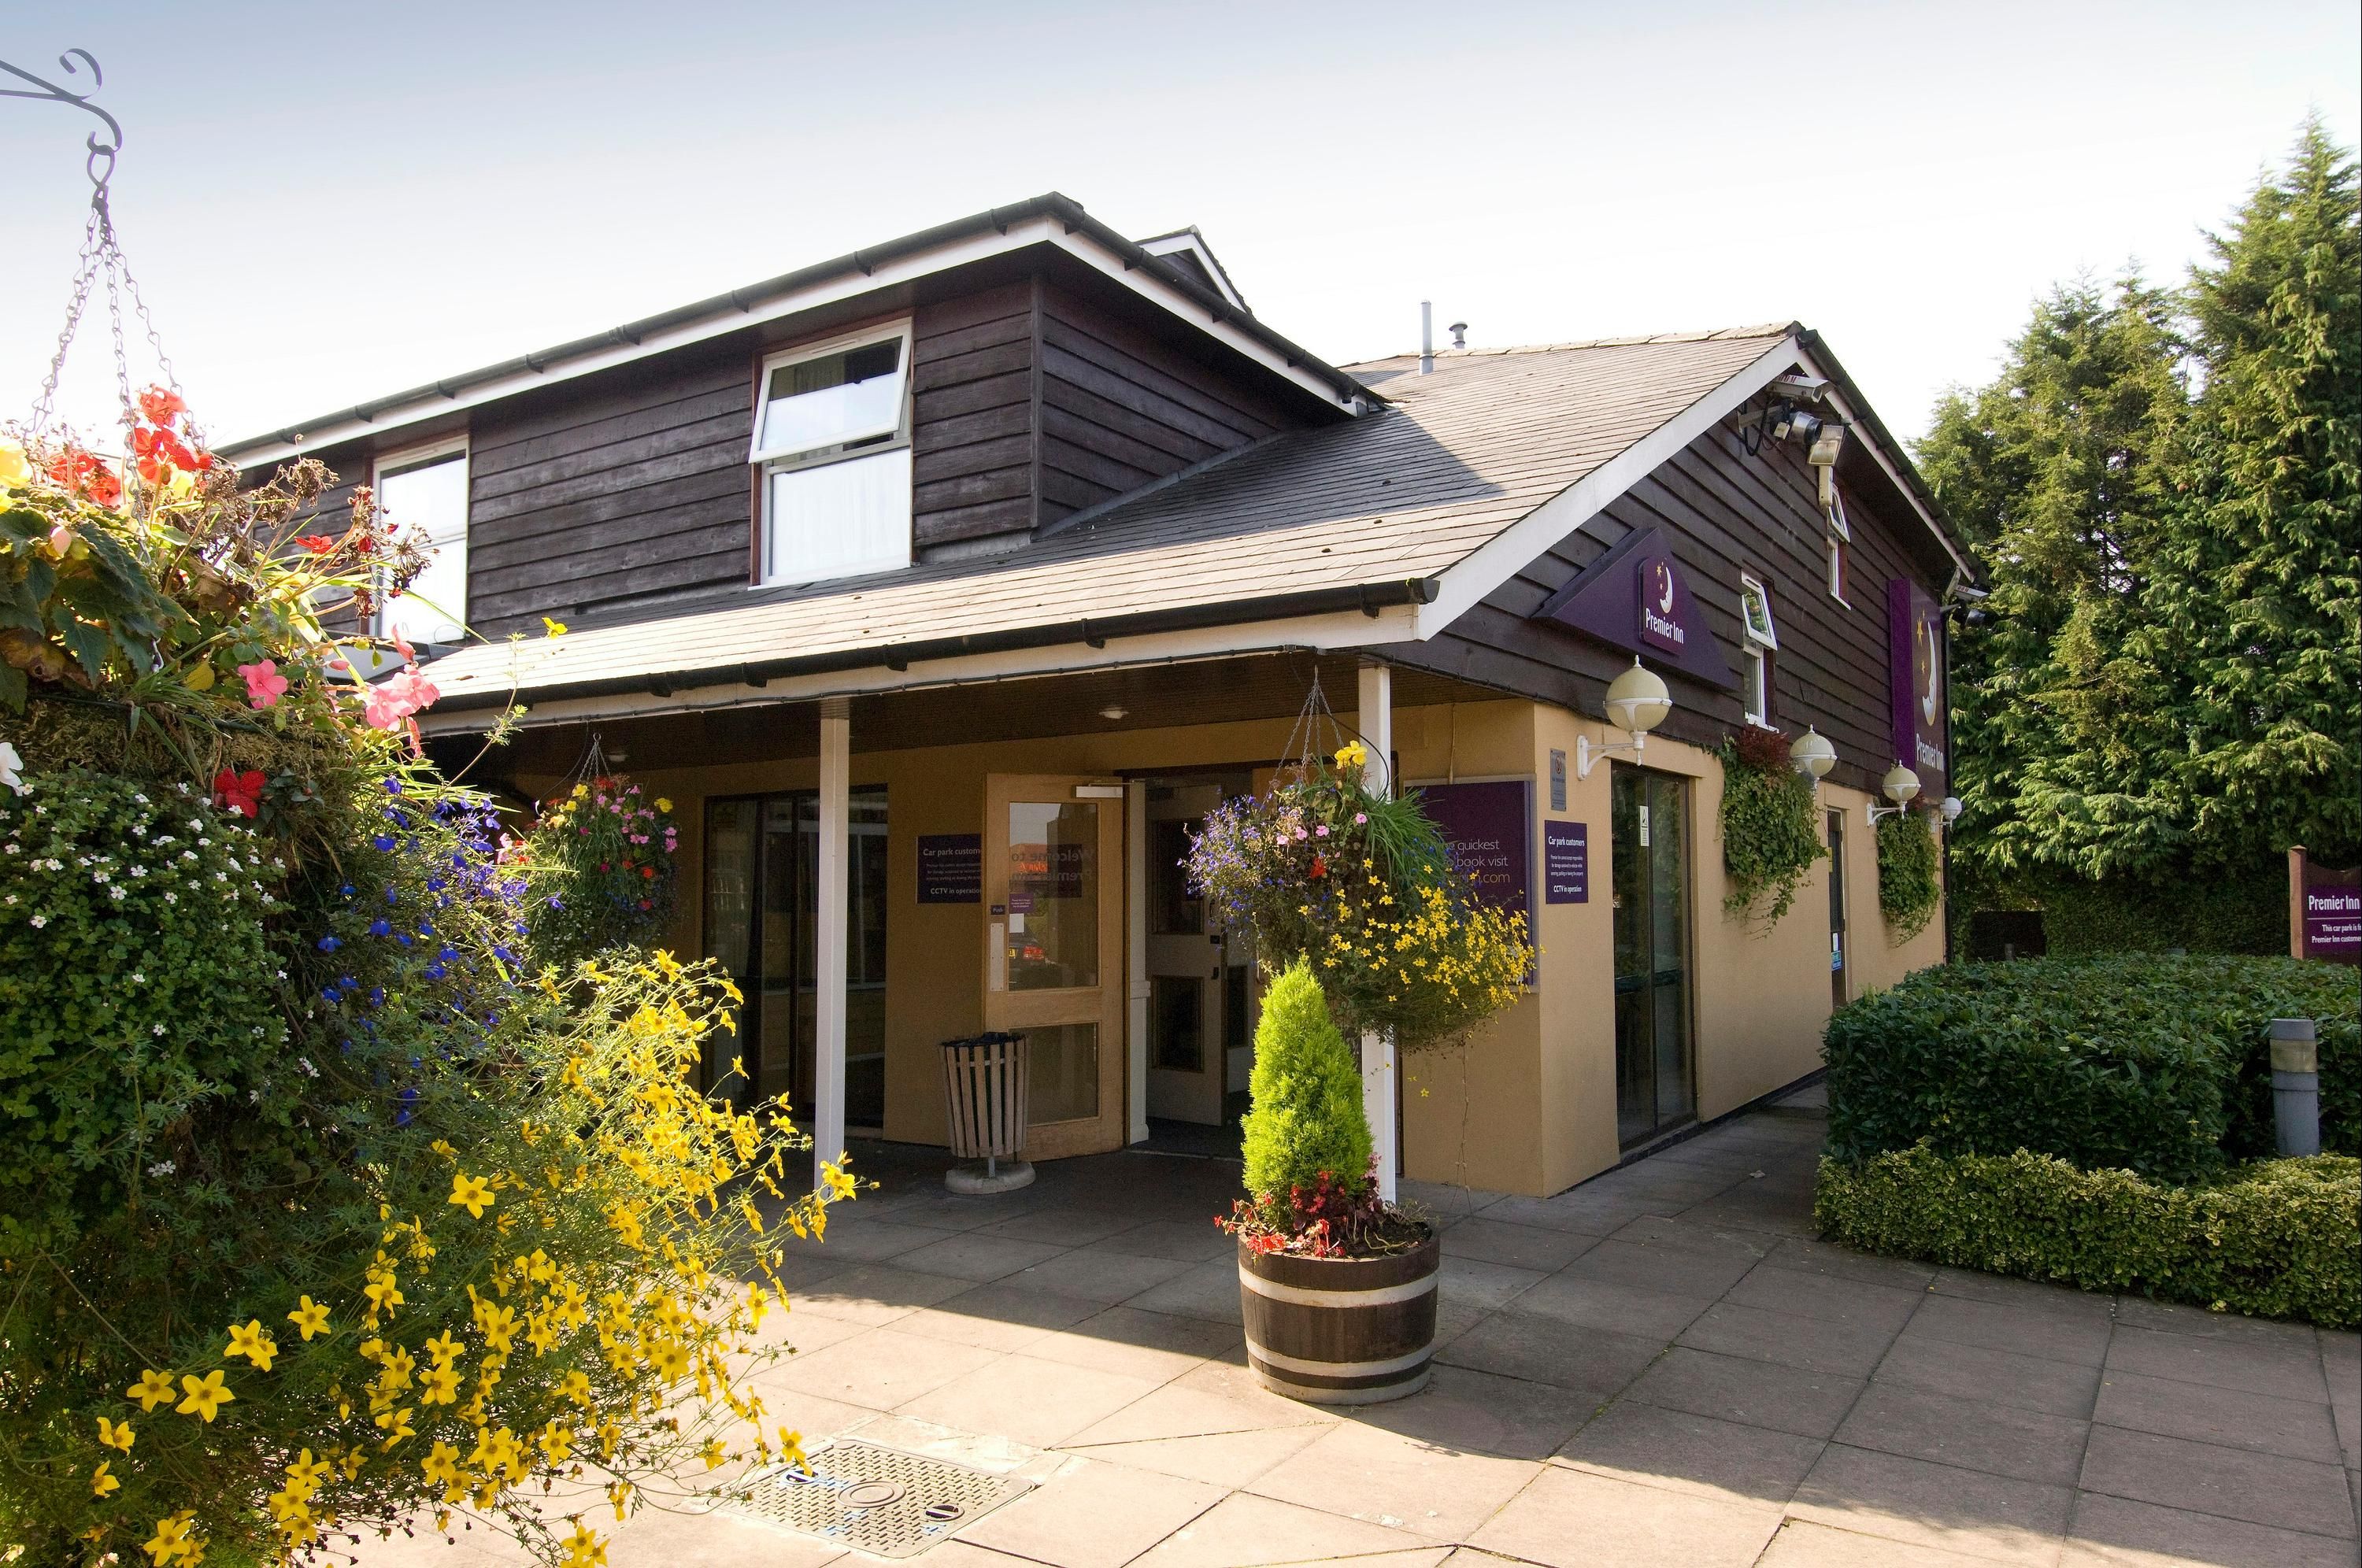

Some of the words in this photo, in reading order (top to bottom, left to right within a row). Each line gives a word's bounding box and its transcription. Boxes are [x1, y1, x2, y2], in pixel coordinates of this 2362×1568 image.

[1646, 608, 1672, 638] Premier
[1673, 621, 1684, 644] Inn
[1916, 733, 1936, 768] Premier
[1557, 837, 1565, 848] park
[1565, 838, 1585, 847] customers
[937, 848, 953, 857] park
[1457, 855, 1486, 867] book
[1487, 854, 1509, 867] visit
[1568, 886, 1582, 894] operation
[2308, 895, 2345, 910] Premier
[2345, 895, 2360, 910] Inn
[2341, 924, 2353, 933] park
